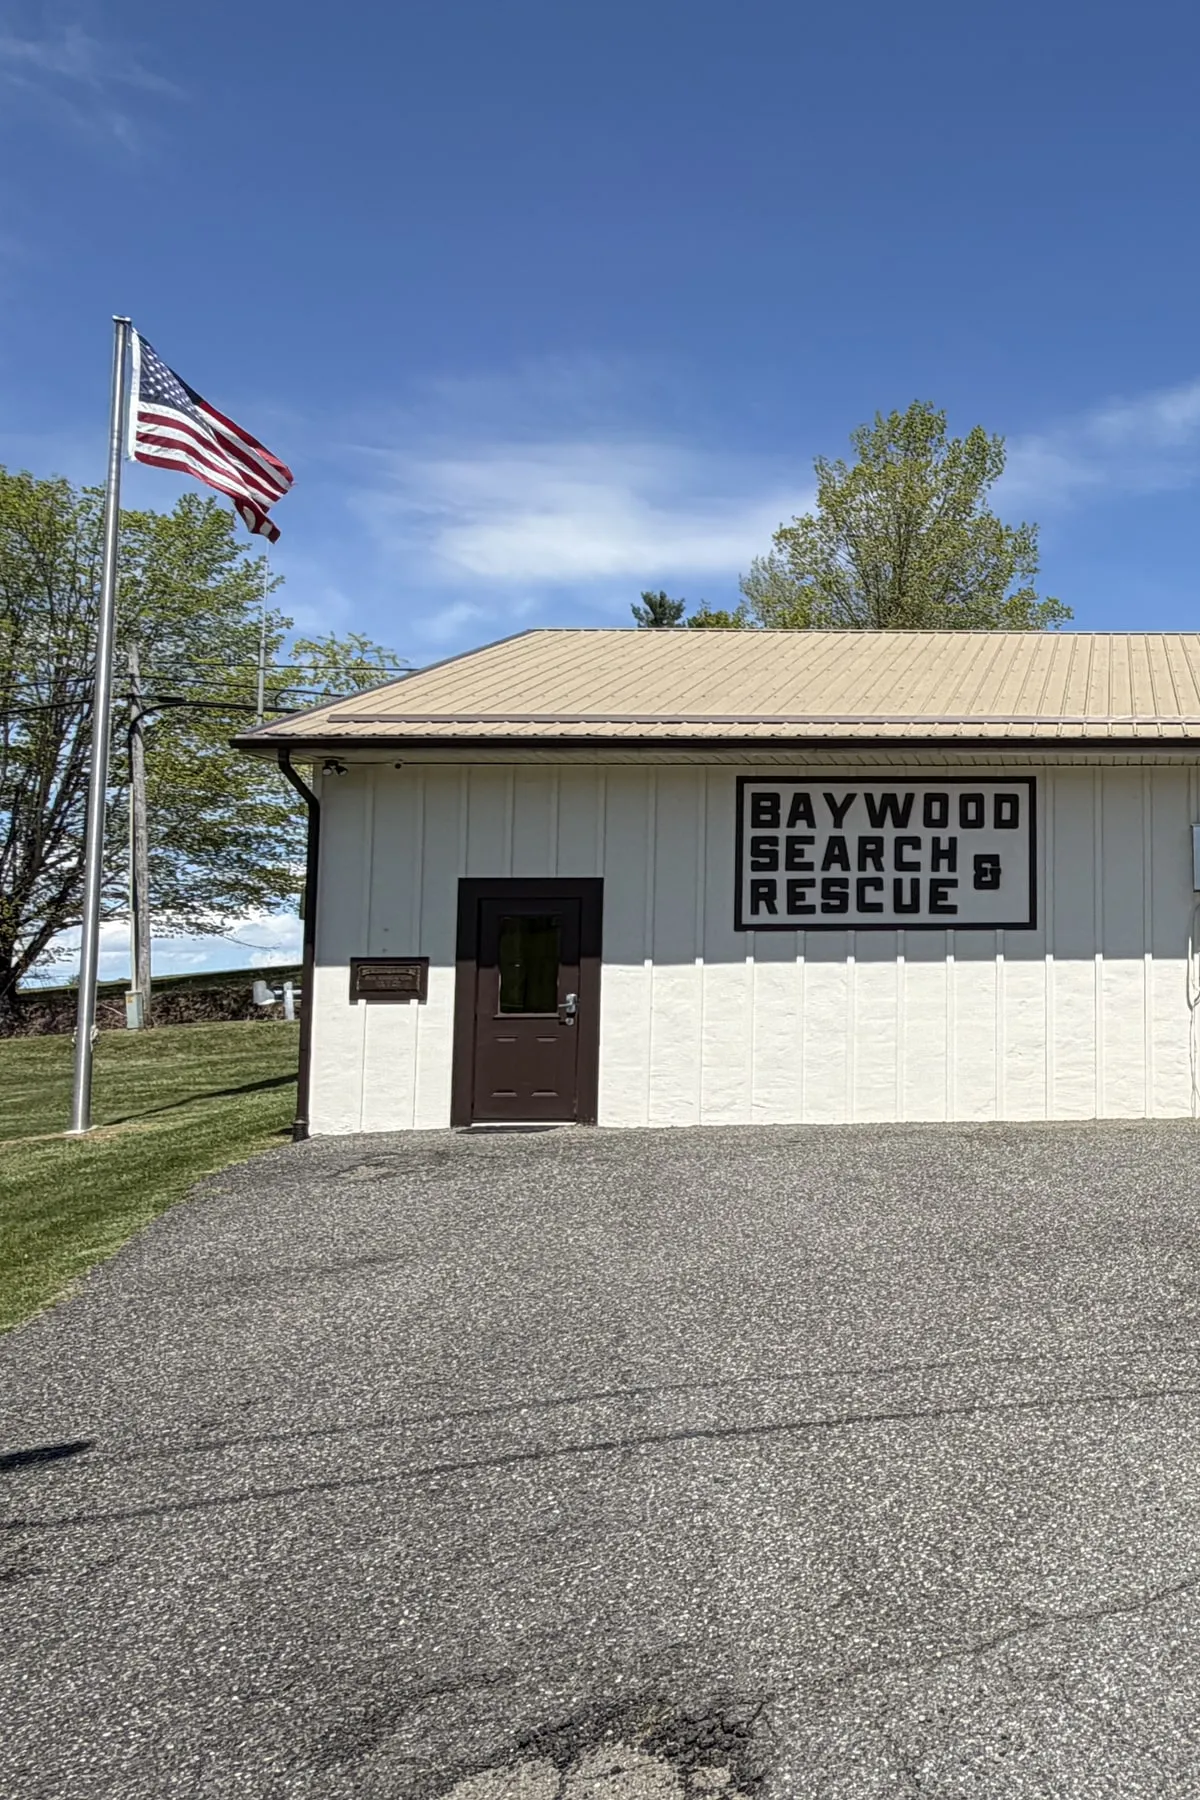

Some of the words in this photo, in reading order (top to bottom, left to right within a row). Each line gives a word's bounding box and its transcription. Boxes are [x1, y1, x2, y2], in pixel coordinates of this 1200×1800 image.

[750, 792, 1020, 830] BAYWOOD
[750, 835, 958, 872] SEARCH
[973, 854, 1002, 890] &
[750, 877, 959, 915] RESCUE
